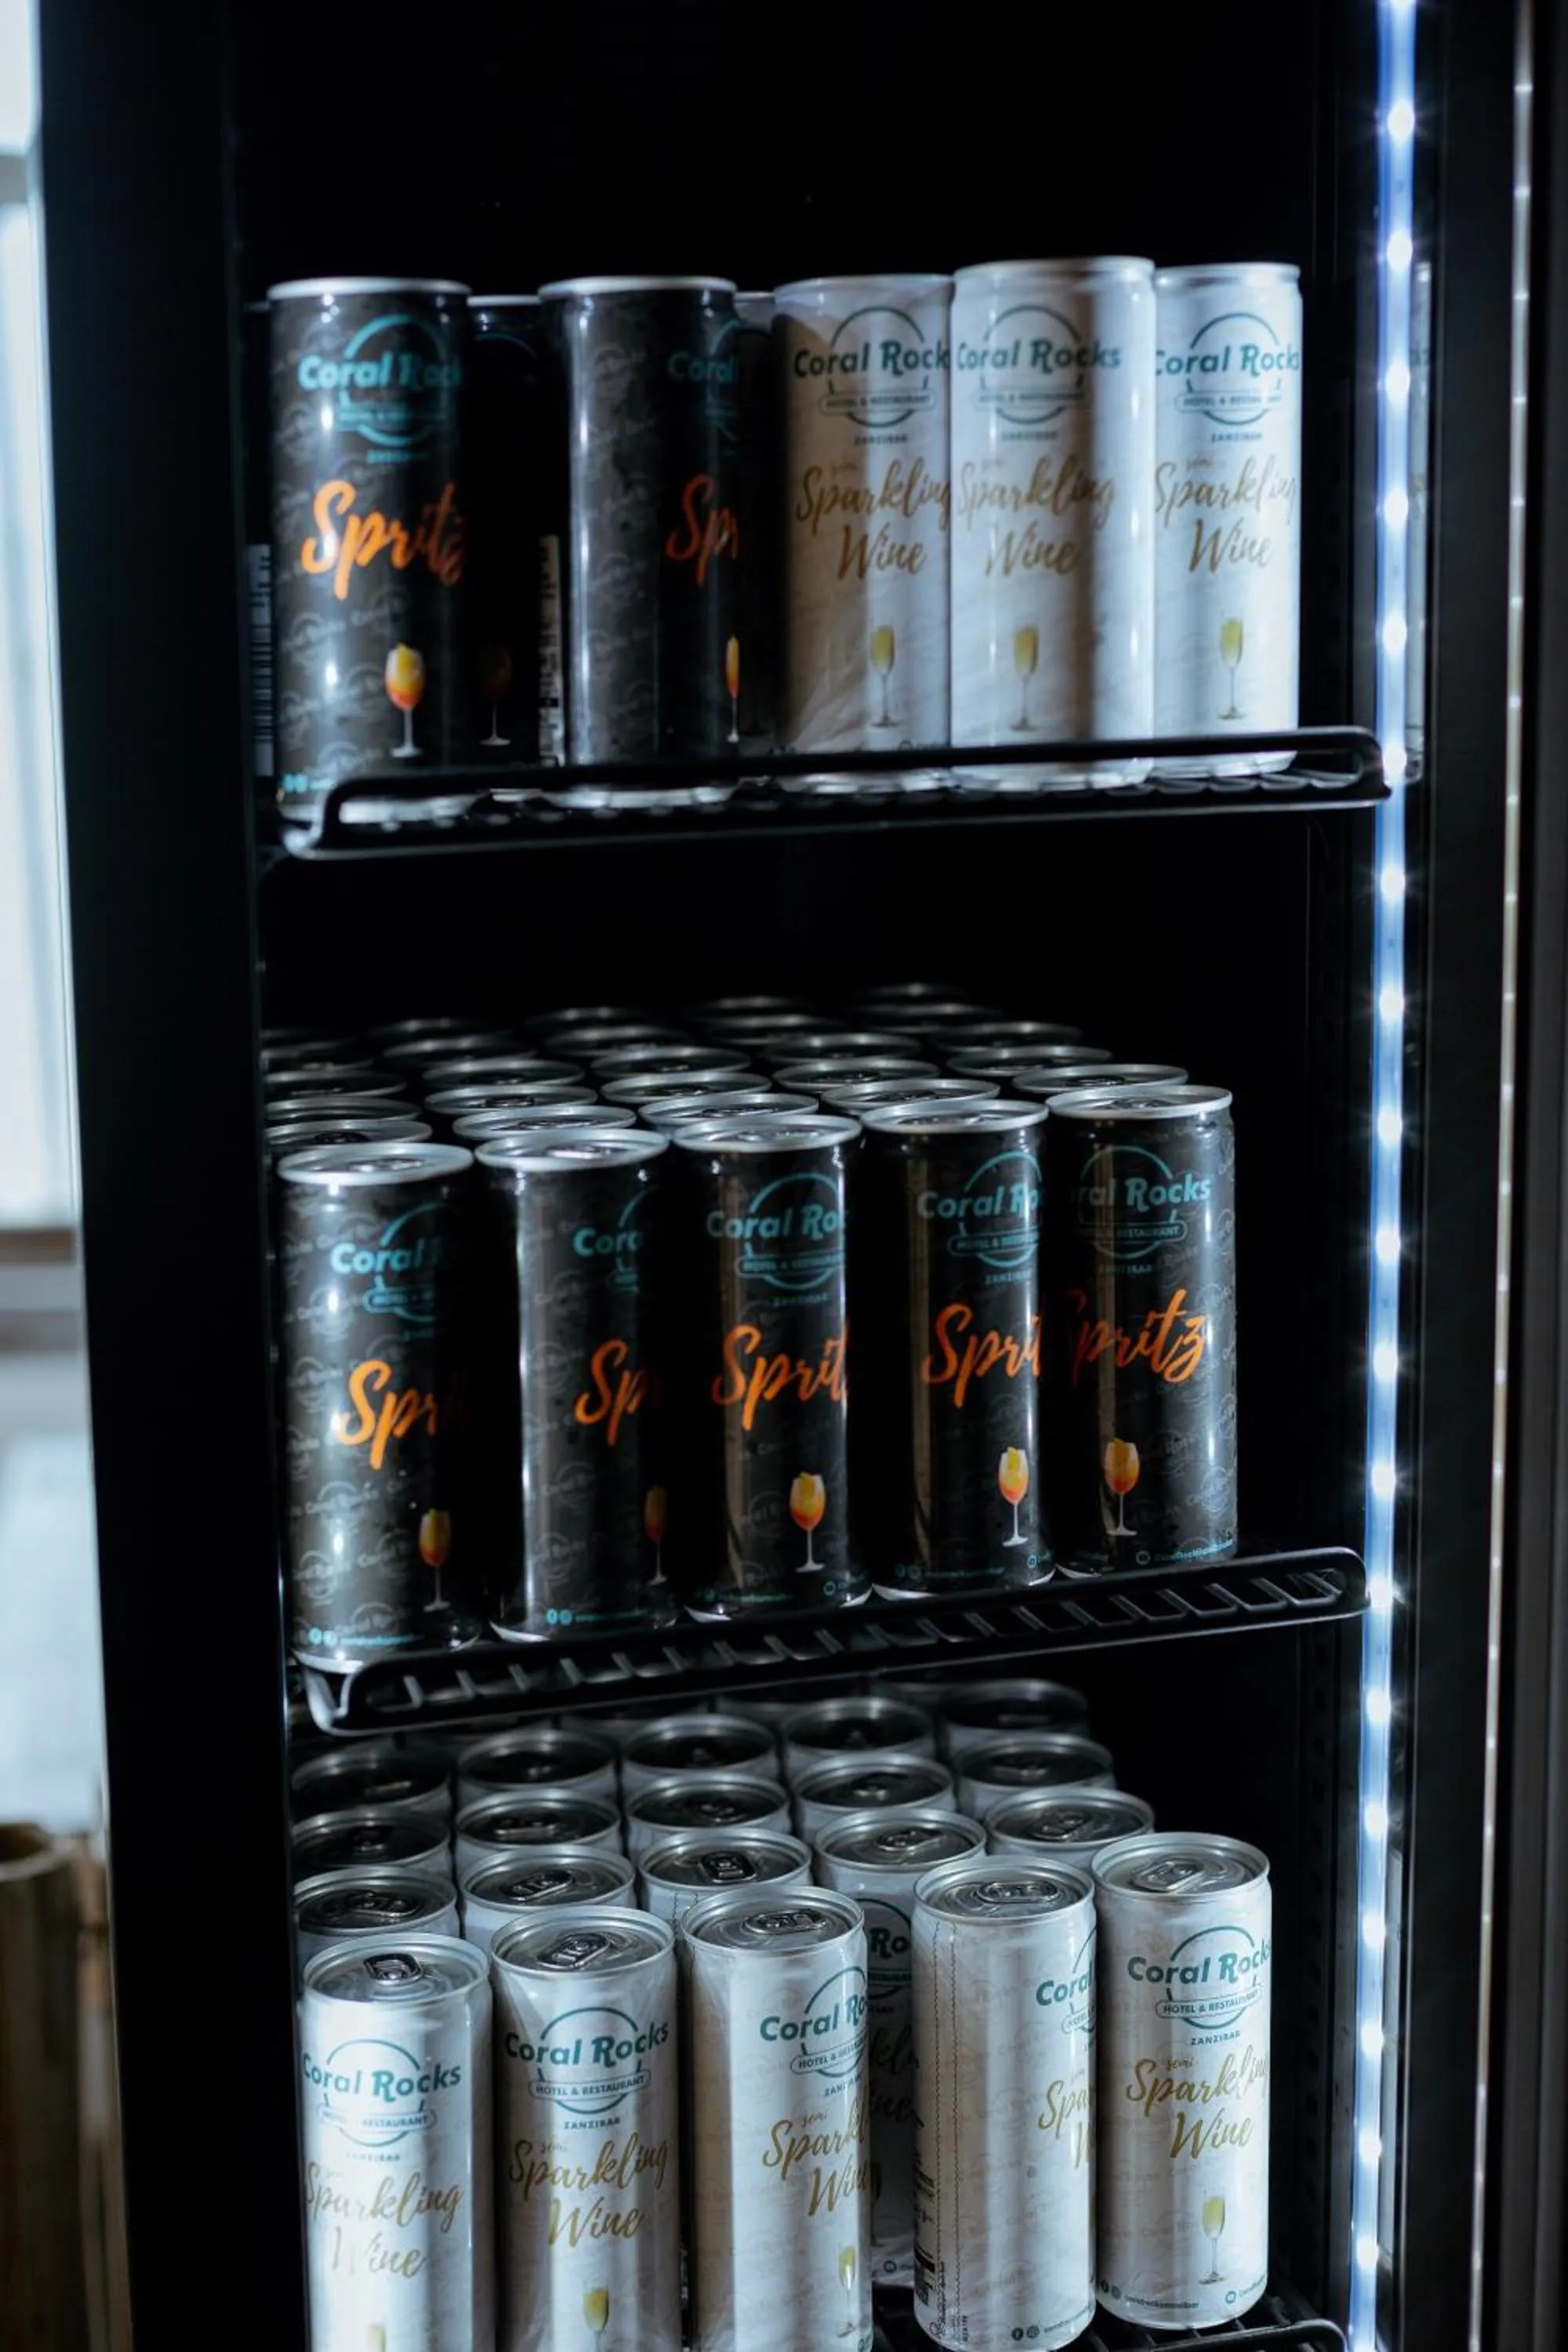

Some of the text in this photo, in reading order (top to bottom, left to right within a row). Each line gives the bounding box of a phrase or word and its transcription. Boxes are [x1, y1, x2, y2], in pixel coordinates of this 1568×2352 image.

[297, 351, 392, 390] Coral
[794, 339, 951, 378] Coral Rock
[957, 337, 1123, 375] Coral Rocks
[956, 452, 1114, 532] Sparkling
[837, 521, 927, 581] Wine
[985, 518, 1082, 578] Wine
[1189, 516, 1275, 574] Wine
[916, 1185, 1005, 1219] Coral
[1124, 1174, 1213, 1214] Rocks
[572, 1225, 646, 1259] Cora
[706, 1206, 795, 1241] Coral
[330, 1237, 426, 1276] Coral
[710, 1323, 848, 1432] Sprit
[334, 1359, 441, 1472] Spr
[1127, 1955, 1211, 1985] Coral
[760, 2003, 840, 2042] Coral
[1190, 2029, 1241, 2046] ZANZIBAR
[506, 2021, 670, 2068] Coral Rocks
[303, 2052, 462, 2103] Coral Rocks
[582, 2074, 646, 2096] RESTAURANT
[564, 2118, 621, 2130] ZANZIBAR
[1169, 2107, 1254, 2159] Wine
[509, 2131, 672, 2202] Sparkling
[305, 2161, 463, 2234] Sparkling
[547, 2196, 647, 2249] Wine
